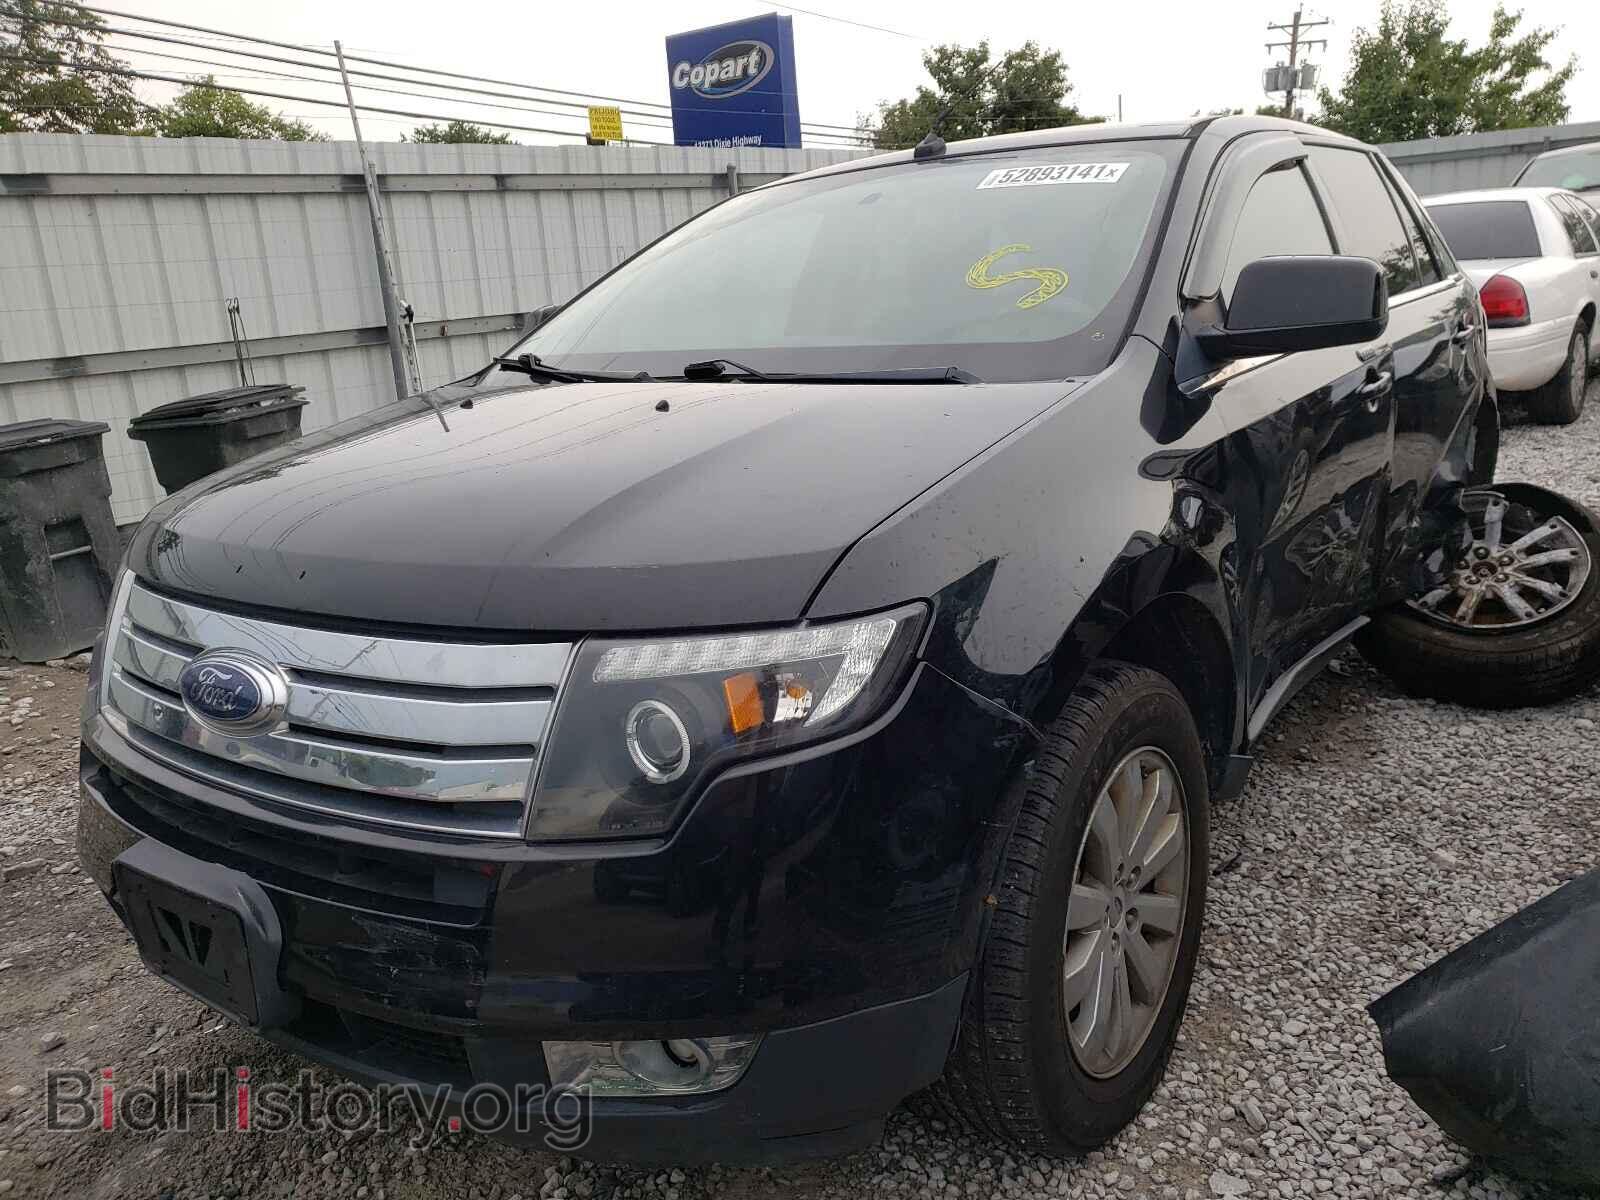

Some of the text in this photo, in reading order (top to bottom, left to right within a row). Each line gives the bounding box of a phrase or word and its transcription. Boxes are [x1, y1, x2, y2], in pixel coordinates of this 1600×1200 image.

[672, 46, 763, 89] Copart
[714, 137, 731, 148] Dixie
[732, 134, 762, 147] Highway
[190, 667, 244, 711] Ford
